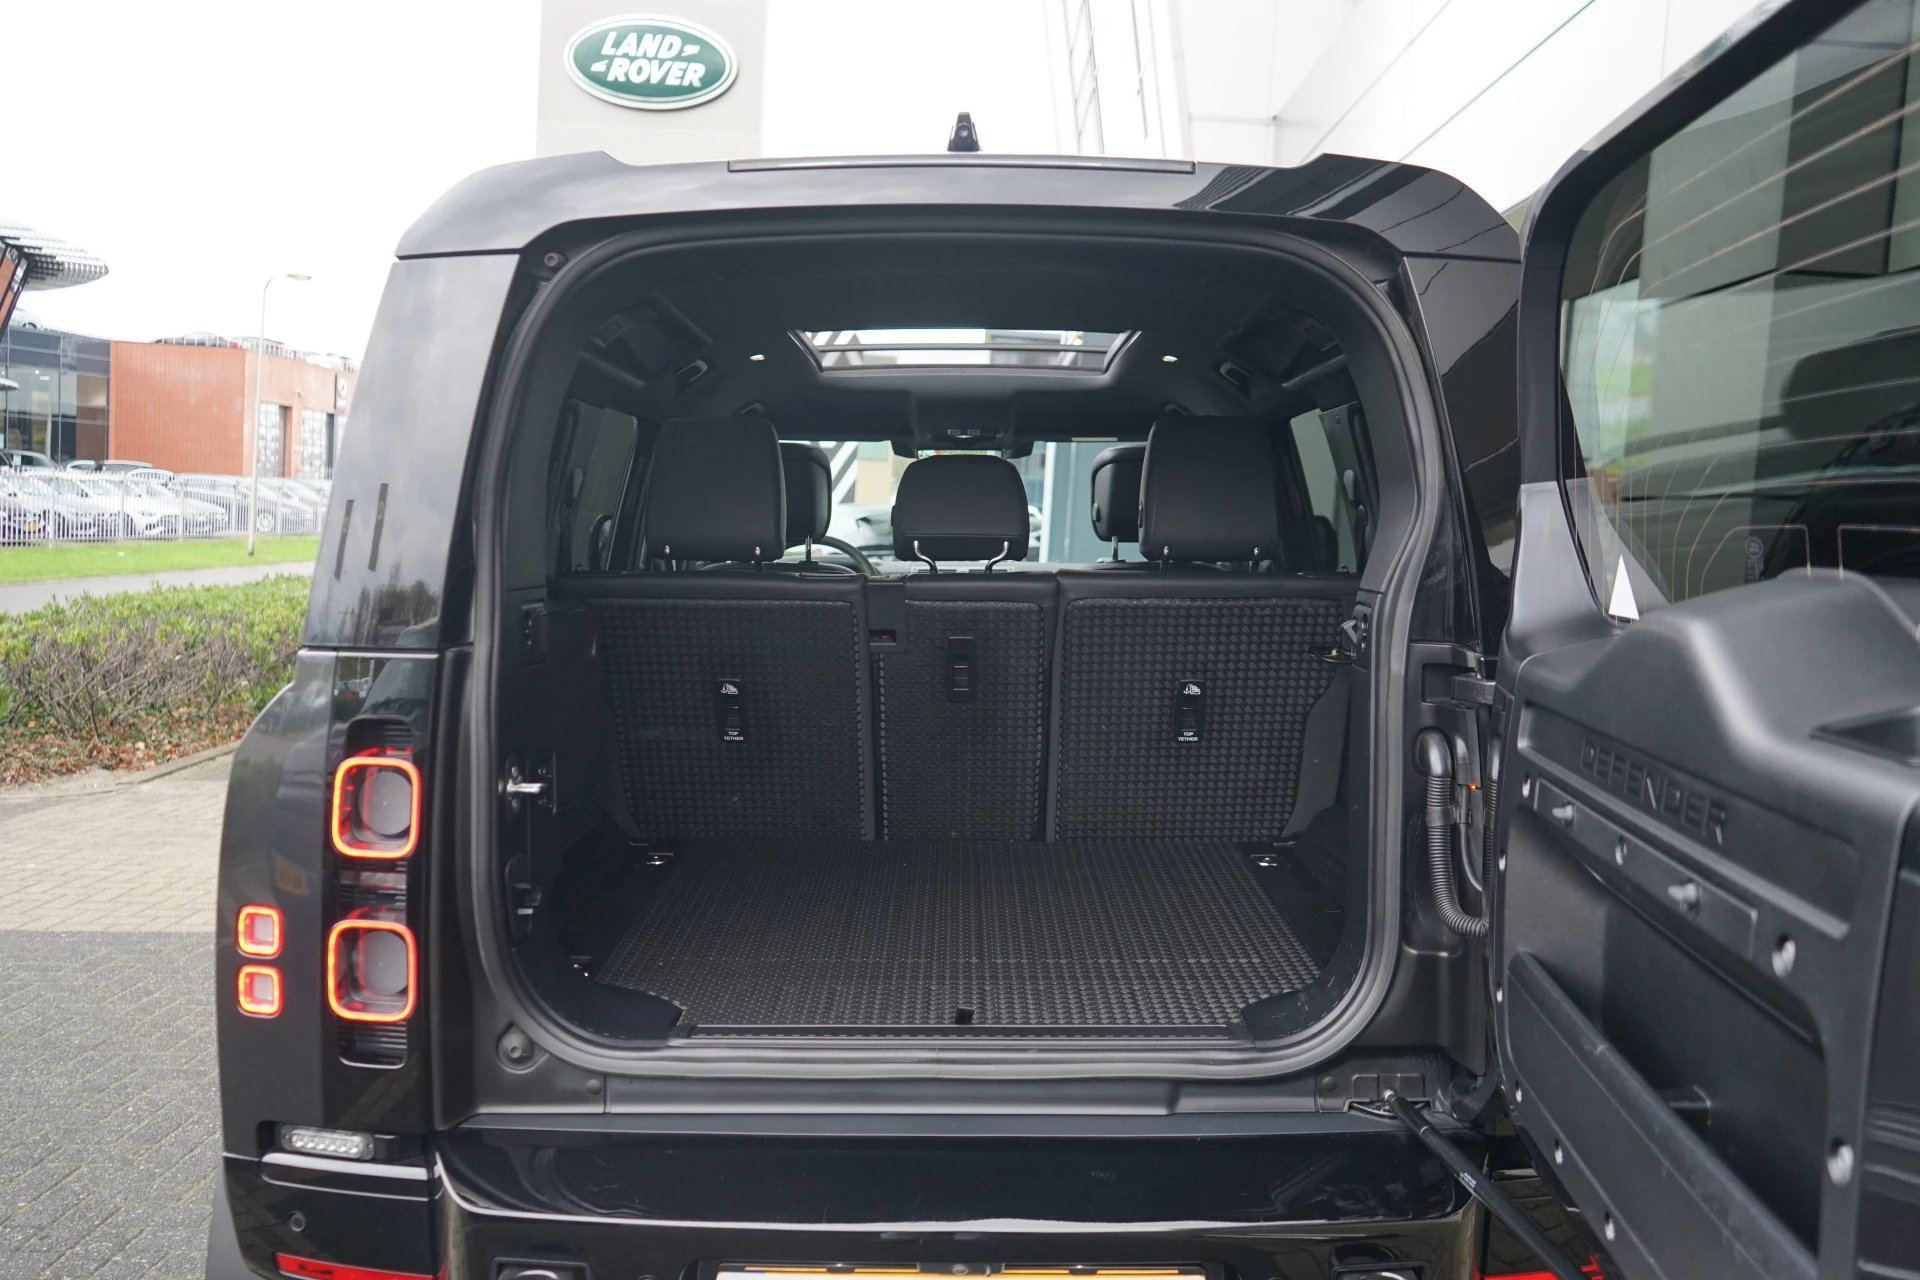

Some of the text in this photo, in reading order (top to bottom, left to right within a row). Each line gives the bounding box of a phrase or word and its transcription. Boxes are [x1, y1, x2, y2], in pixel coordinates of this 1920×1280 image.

[601, 31, 683, 59] LAND
[606, 57, 706, 87] ROVER
[1579, 738, 1728, 846] DEFENDER
